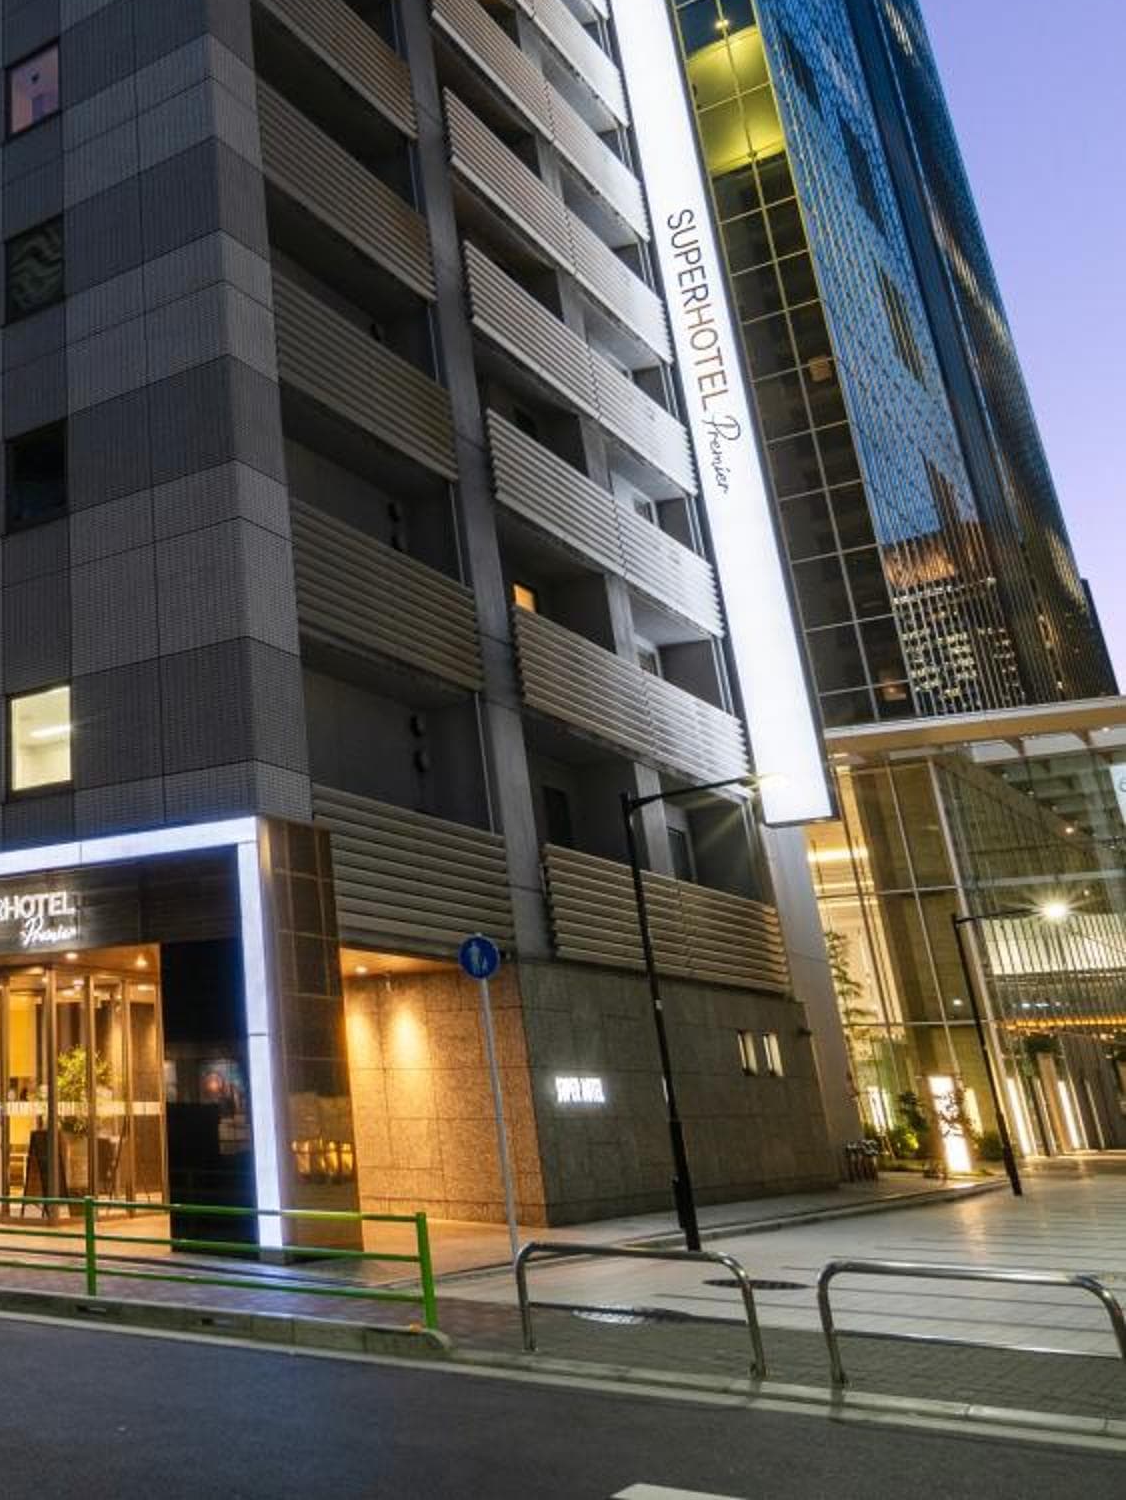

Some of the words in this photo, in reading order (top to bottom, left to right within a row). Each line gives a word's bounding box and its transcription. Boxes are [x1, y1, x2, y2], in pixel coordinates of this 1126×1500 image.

[667, 208, 729, 412] SUPERHOTEL
[703, 412, 741, 495] Premier
[20, 916, 77, 947] Premier
